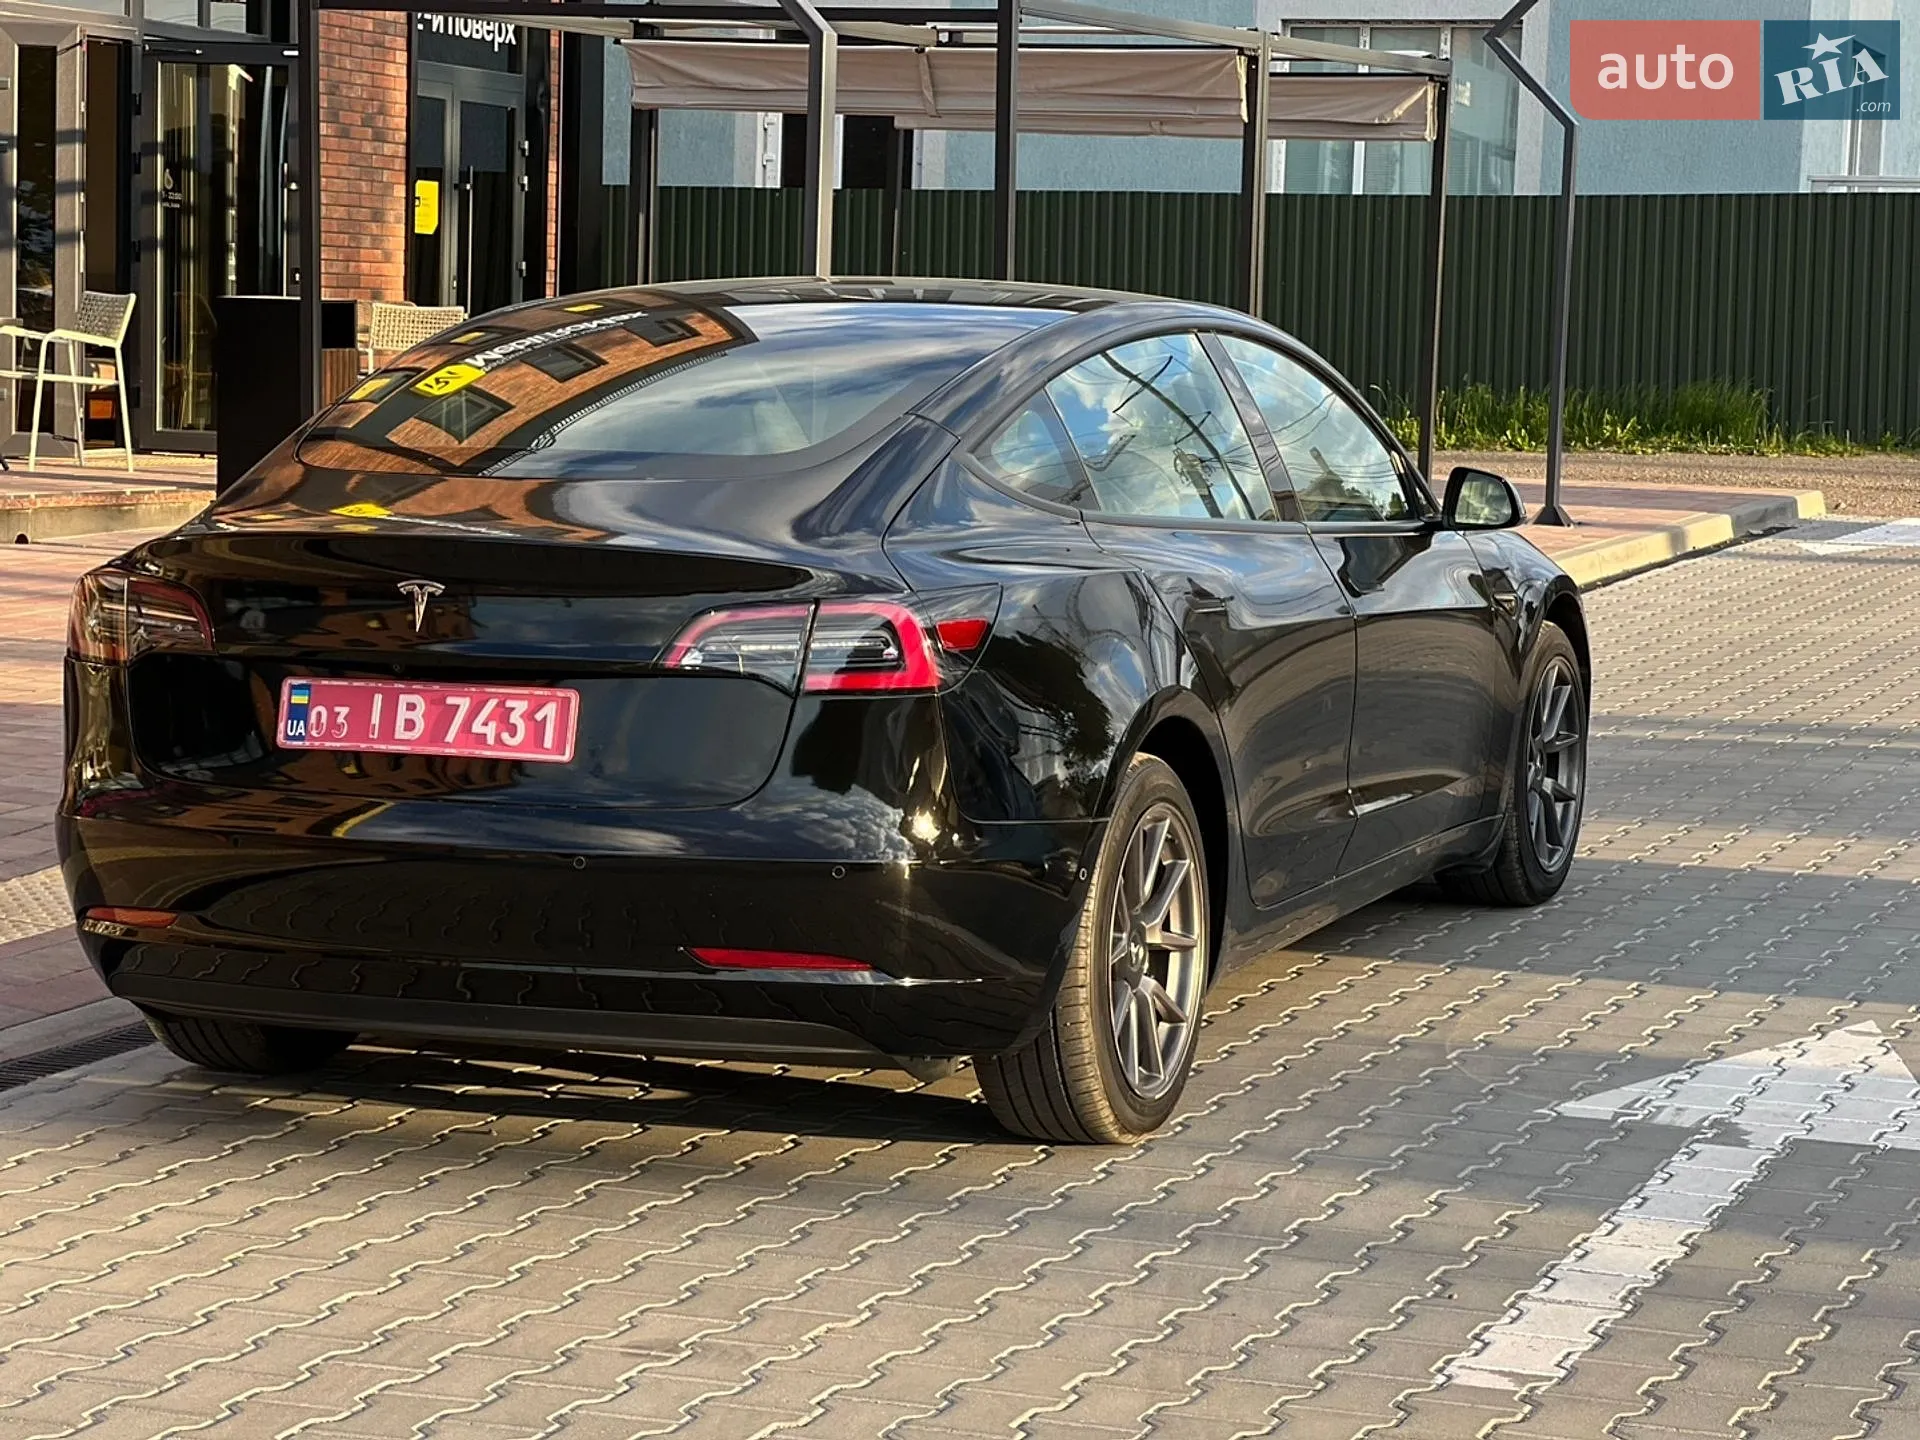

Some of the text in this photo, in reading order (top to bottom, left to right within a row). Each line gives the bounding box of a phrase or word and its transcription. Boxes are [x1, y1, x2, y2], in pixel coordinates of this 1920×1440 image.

[287, 719, 305, 736] UA
[310, 705, 350, 739] 03
[444, 696, 557, 749] 7431
